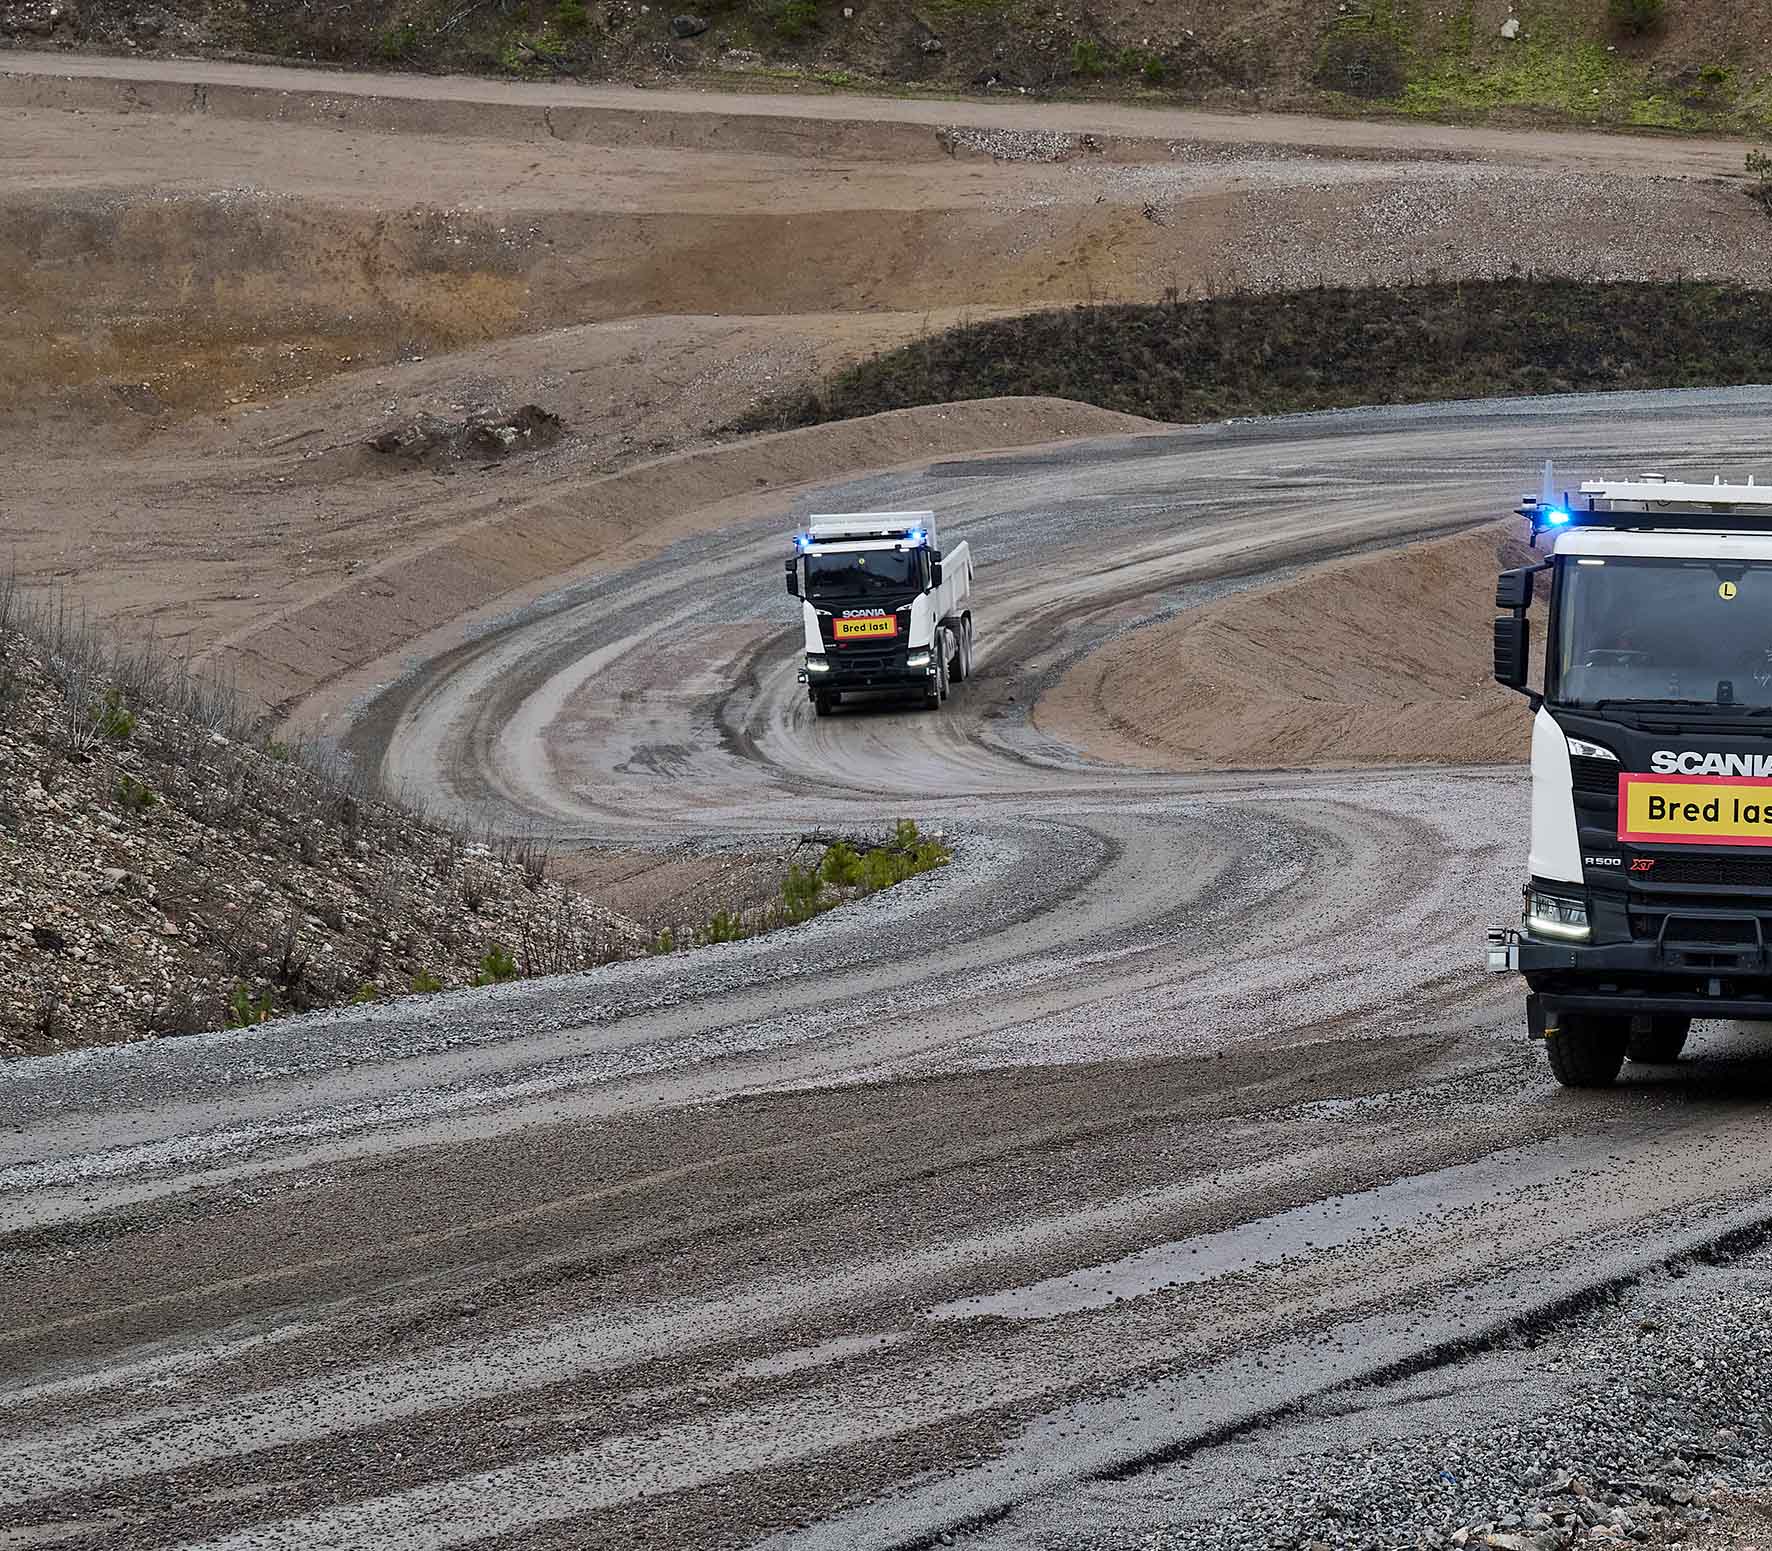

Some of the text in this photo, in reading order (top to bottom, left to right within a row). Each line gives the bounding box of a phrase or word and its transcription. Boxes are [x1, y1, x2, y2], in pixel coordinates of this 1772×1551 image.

[1724, 583, 1734, 597] L
[842, 608, 886, 618] SCANIA
[843, 622, 888, 632] Bred last
[1648, 795, 1721, 823] Bred
